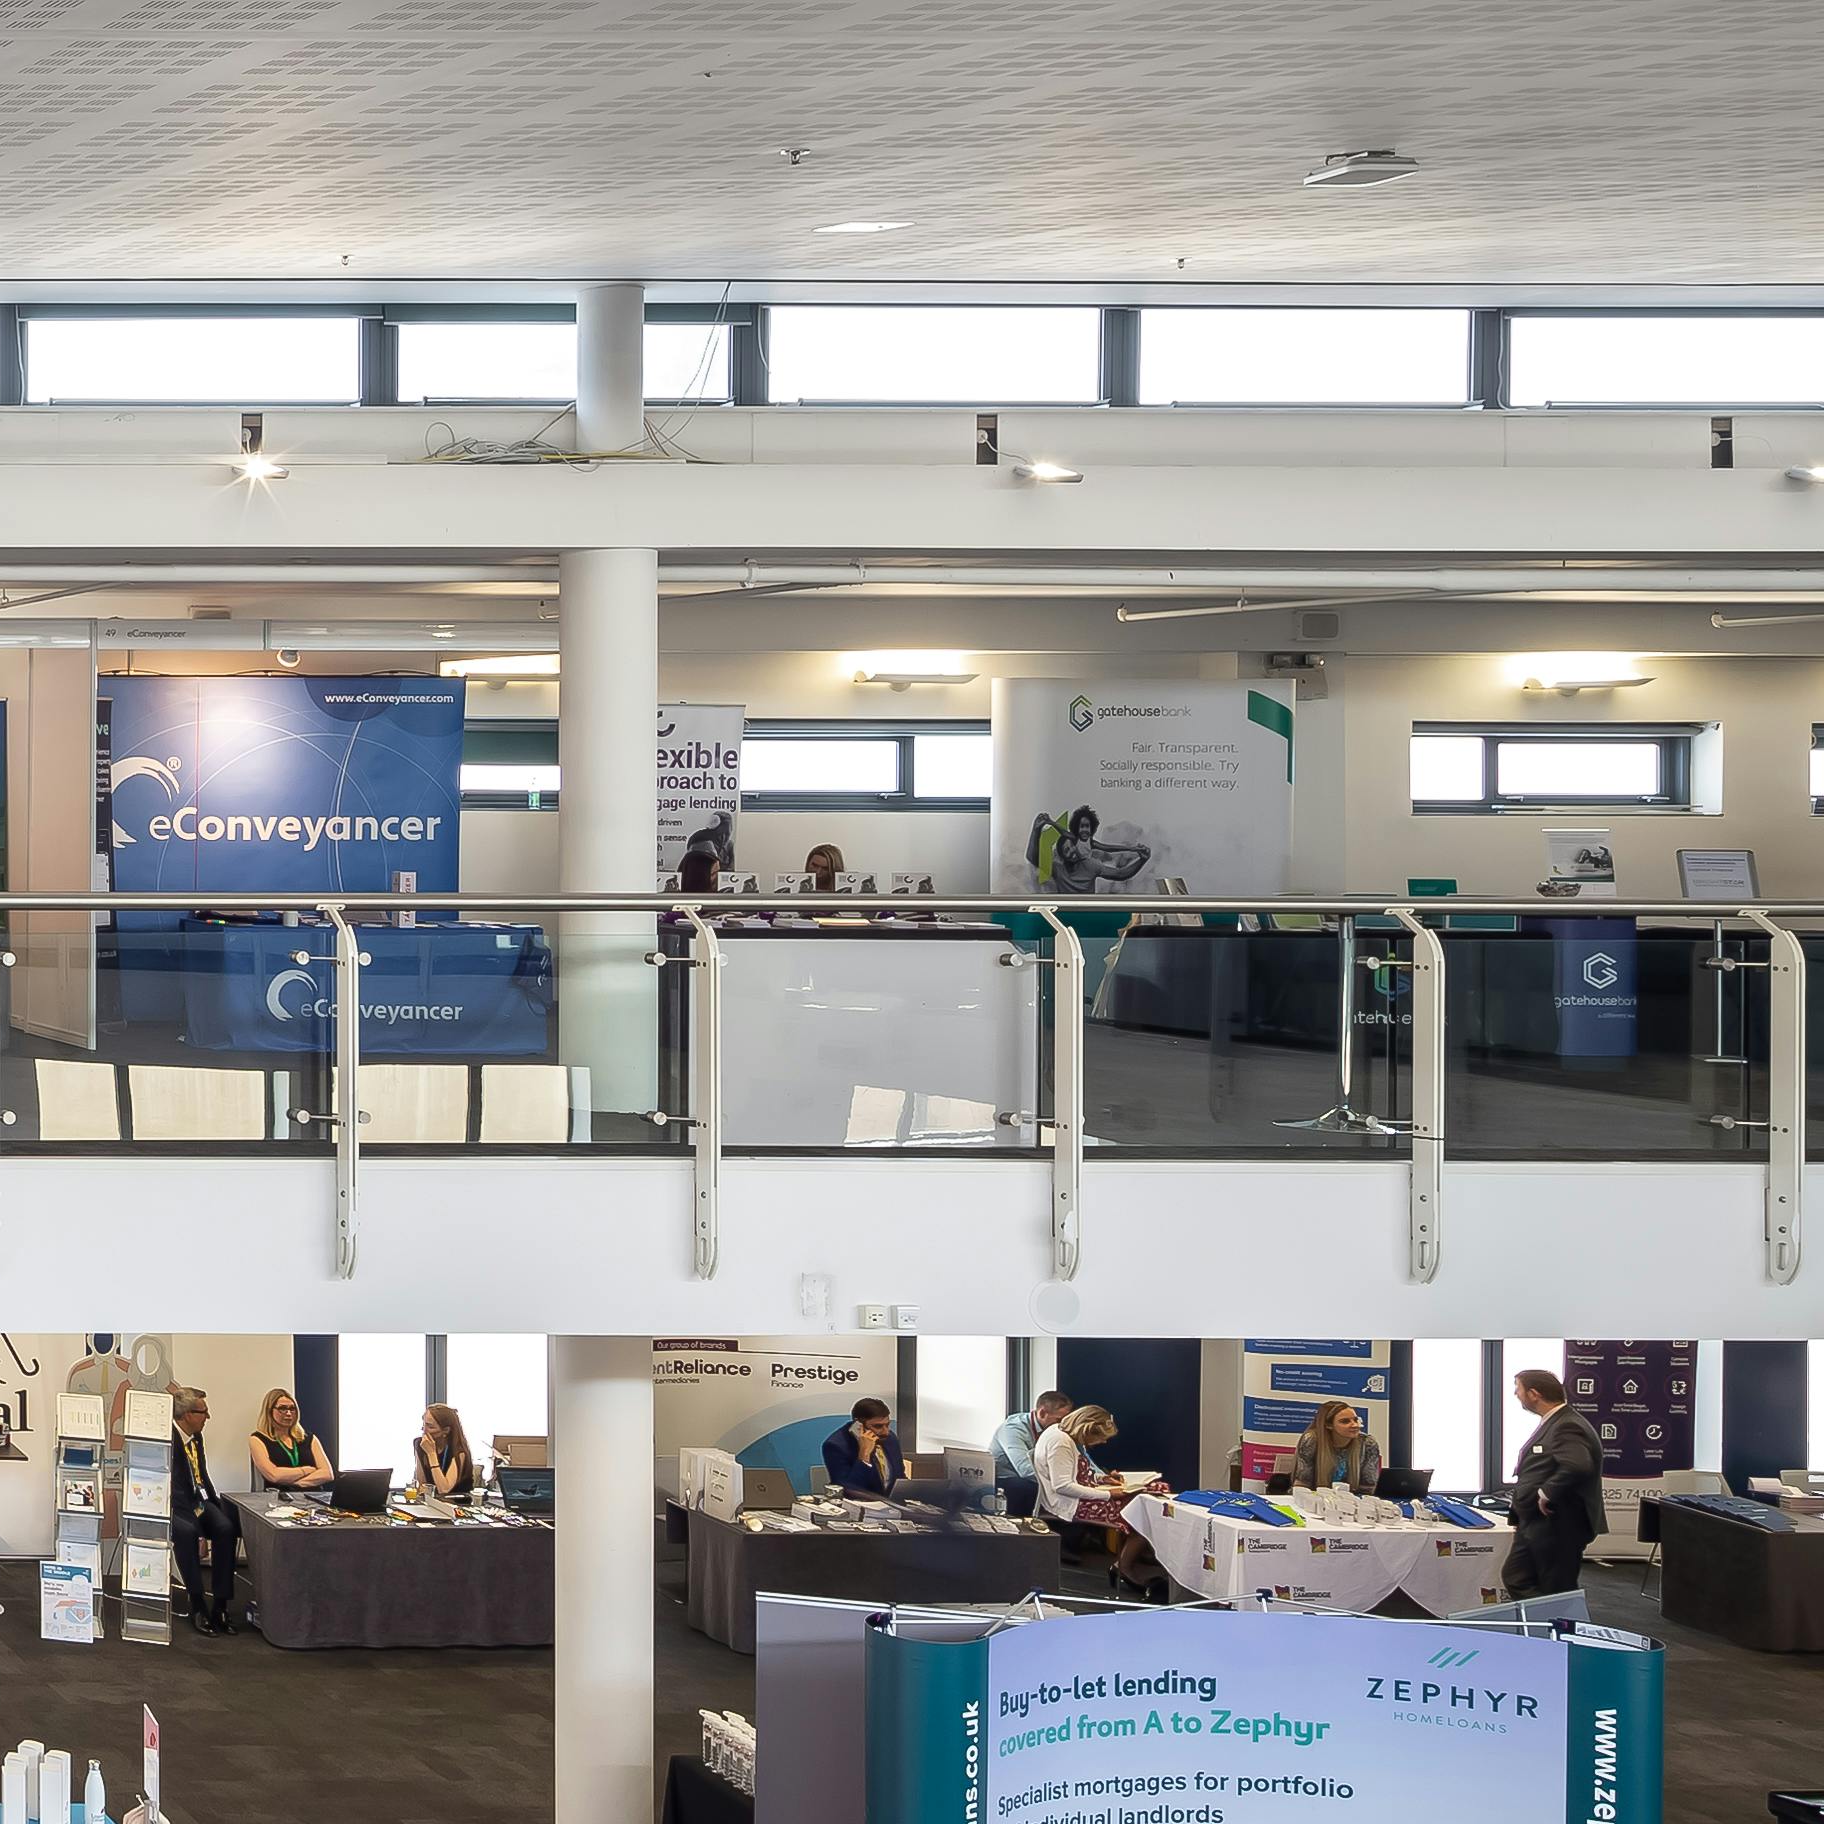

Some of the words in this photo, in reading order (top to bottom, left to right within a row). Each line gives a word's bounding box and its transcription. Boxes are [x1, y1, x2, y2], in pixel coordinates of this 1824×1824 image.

[106, 629, 116, 637] 49
[127, 629, 185, 638] eConveyancer
[325, 694, 454, 705] www.eConveyancer.com
[1132, 741, 1153, 754] Fair.
[1158, 741, 1239, 756] Transparent.
[1099, 760, 1138, 773] Socially
[1141, 760, 1214, 773] responsible.
[1219, 760, 1239, 774] Try
[1100, 777, 1139, 792] banking
[1154, 777, 1204, 789] different
[1209, 781, 1239, 792] way.
[690, 796, 736, 812] lending
[150, 807, 440, 851] eConveyancer
[670, 1342, 689, 1351] group
[700, 1342, 726, 1350] brands
[1329, 1542, 1369, 1551] CAMBRIDGE
[1454, 1546, 1494, 1554] CAMBRIDGE
[999, 1674, 1107, 1718] Buy-to-let
[1114, 1670, 1218, 1704] lending
[1366, 1676, 1540, 1719] ZEPHYR
[1393, 1711, 1507, 1734] HOMELOANS
[999, 1718, 1072, 1758] covered
[1077, 1715, 1136, 1740] from
[1144, 1712, 1164, 1735] A
[1171, 1711, 1202, 1735] to
[1210, 1710, 1331, 1746] Zephyr
[998, 1779, 1069, 1817] Specialist
[1074, 1773, 1186, 1803] mortgages
[1194, 1771, 1229, 1792] for
[1237, 1773, 1354, 1801] portfolio
